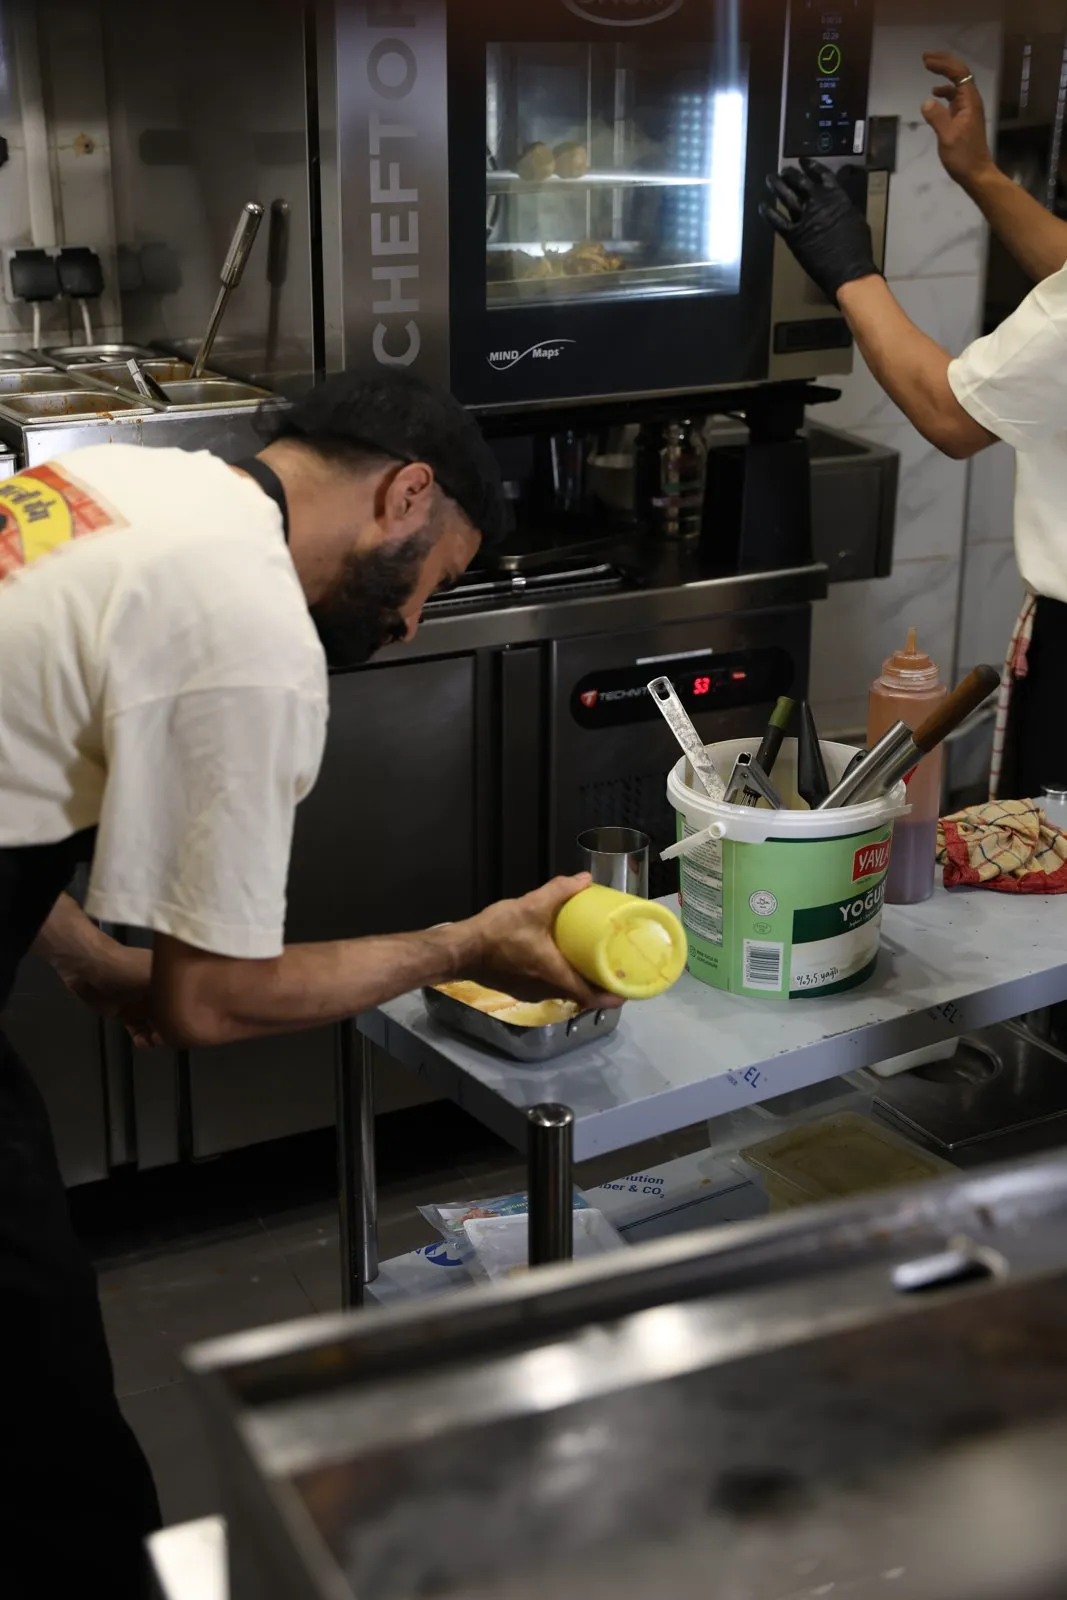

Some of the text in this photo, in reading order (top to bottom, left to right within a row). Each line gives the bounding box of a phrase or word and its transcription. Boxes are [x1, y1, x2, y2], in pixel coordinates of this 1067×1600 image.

[489, 348, 559, 361] MIND Maps
[840, 876, 887, 922] YOĞUR
[796, 973, 818, 986] %3,5
[628, 1184, 638, 1193] &
